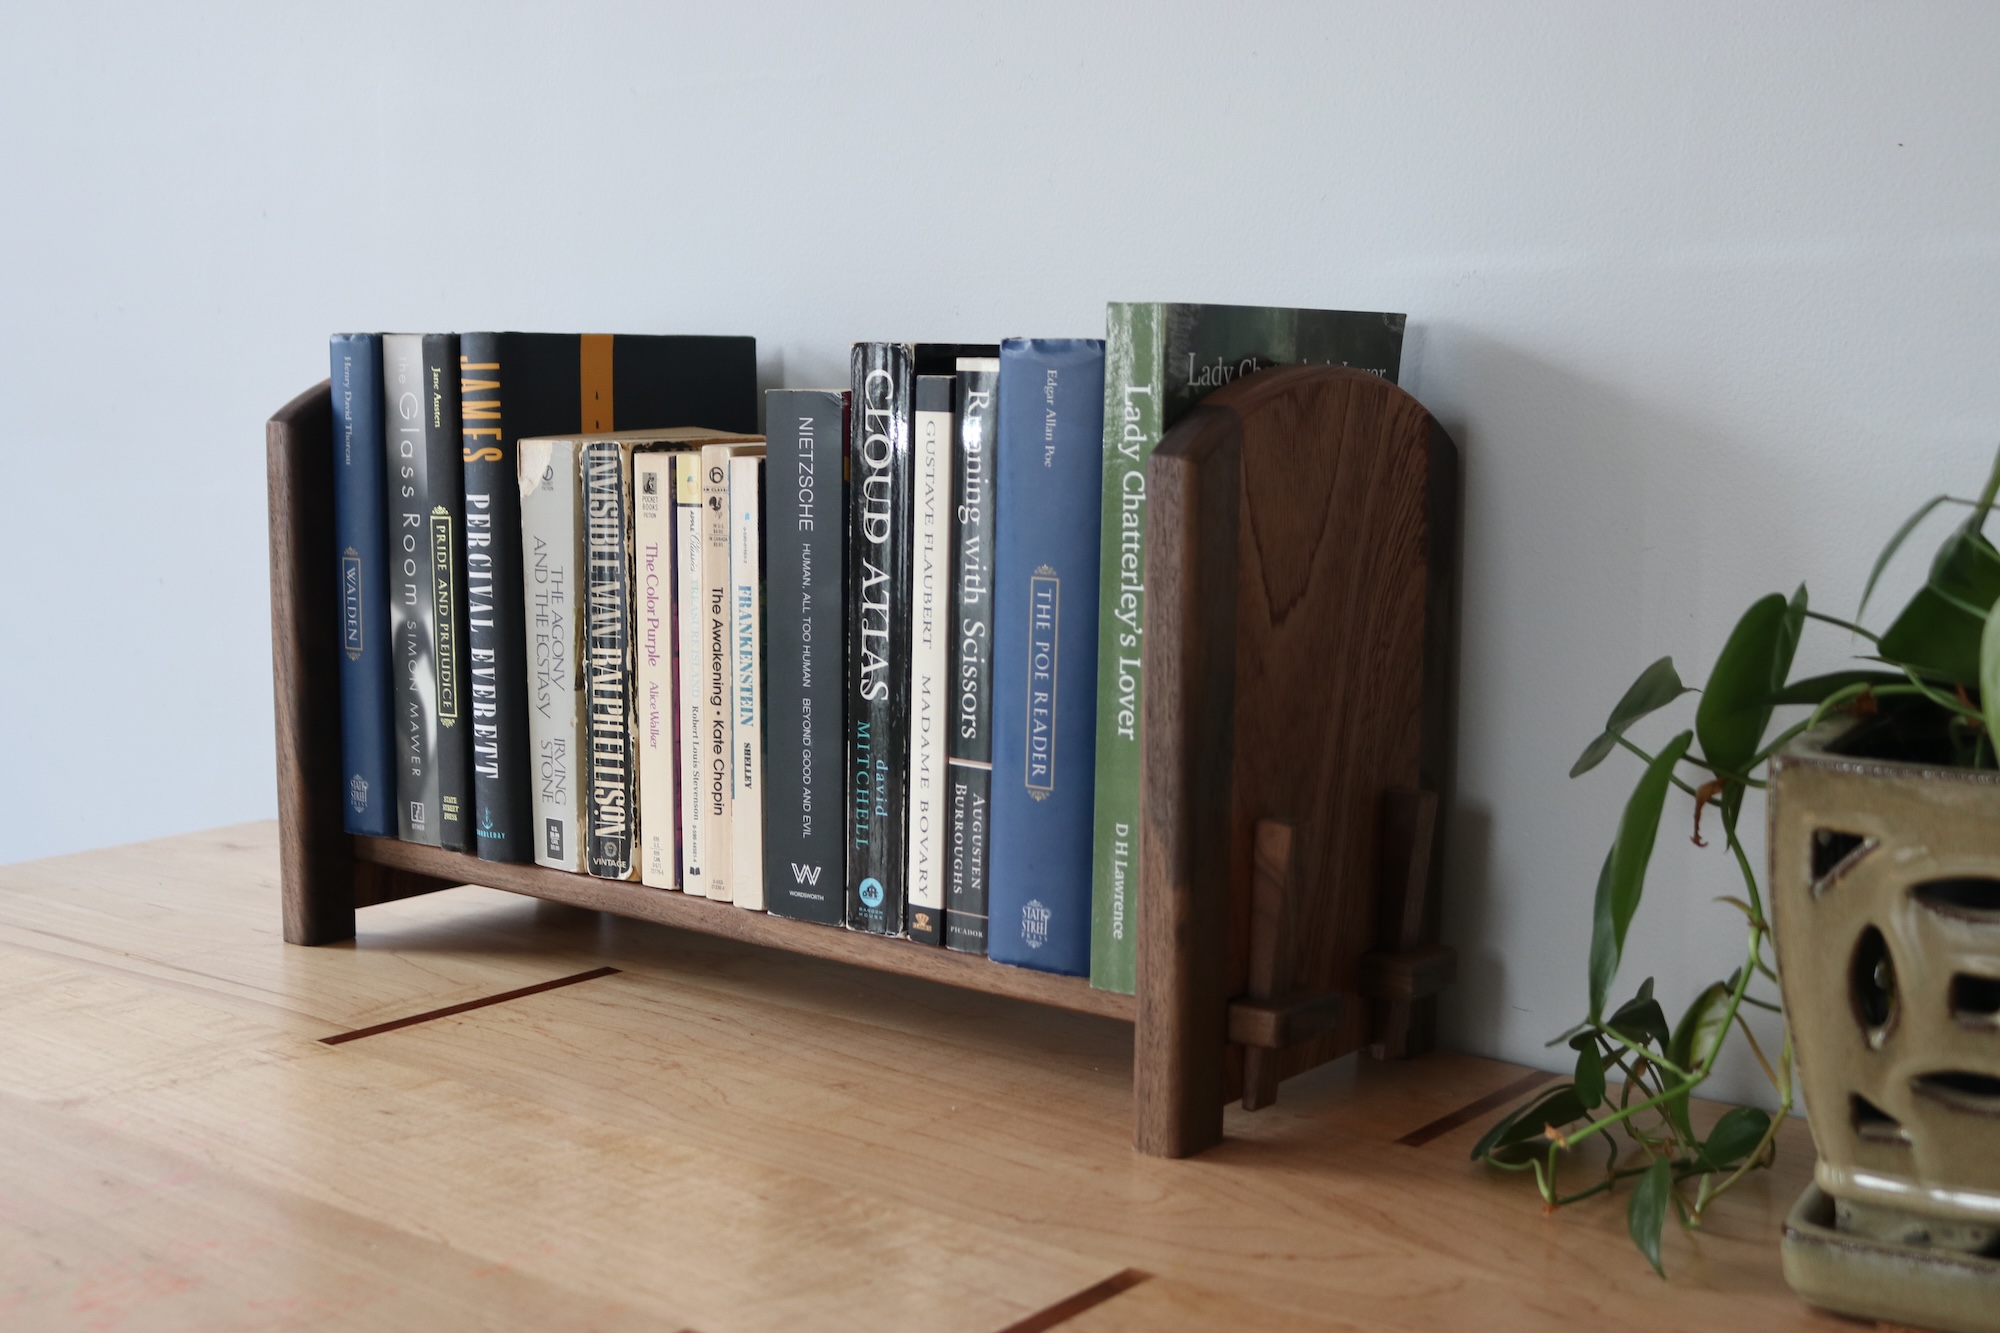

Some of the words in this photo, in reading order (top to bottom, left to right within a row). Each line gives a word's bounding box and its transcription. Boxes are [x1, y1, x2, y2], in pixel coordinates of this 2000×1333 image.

[344, 356, 352, 389] Henry
[431, 366, 441, 390] Jane
[1043, 369, 1057, 405] Edgar
[1187, 352, 1235, 386] Lady
[344, 391, 353, 421] David
[433, 391, 441, 428] Austen
[460, 355, 503, 463] JAMES
[1044, 407, 1056, 441] Allan
[1118, 384, 1151, 462] Lady
[345, 422, 353, 466] Thoreau
[399, 392, 420, 498] Glass
[863, 368, 894, 545] CLOUD
[1044, 443, 1055, 469] Poe
[798, 416, 814, 532] NIETZSCHE
[924, 420, 936, 527] GUSTAVE
[589, 450, 620, 575] INVISIBLE
[642, 496, 658, 504] POCKET
[642, 503, 658, 511] BOOKS
[402, 513, 420, 605] Room
[436, 525, 446, 571] PRIDE
[466, 493, 494, 633] PERCIVAL
[533, 535, 549, 584] AND
[645, 543, 658, 571] The
[690, 532, 701, 572] Classics
[801, 542, 811, 590] HUMAN,
[963, 535, 988, 605] with
[1114, 470, 1147, 647] Chatterley's
[346, 567, 358, 641] WALDEN
[438, 579, 448, 621] AND
[535, 591, 549, 627] THE
[551, 566, 563, 604] THE
[645, 573, 659, 616] Color
[712, 587, 724, 613] The
[801, 592, 811, 614] ALL
[922, 532, 934, 650] FLAUBERT
[1035, 588, 1052, 630] THE
[590, 580, 621, 640] MAN
[690, 579, 699, 647] TREASURE
[801, 616, 811, 644] TOO
[859, 557, 892, 702] ATLAS
[406, 620, 418, 692] SIMON
[440, 623, 452, 708] PREJUDICE
[551, 610, 565, 692] AGONY
[645, 617, 660, 668] Purple
[710, 617, 724, 707] Awakening
[739, 584, 754, 727] FRANKENSTEIN
[801, 645, 811, 688] HUMAN
[1034, 640, 1050, 681] POE
[536, 634, 551, 719] ECSTASY
[592, 647, 623, 732] RALPH
[650, 681, 659, 709] Alice
[691, 654, 700, 698] ISLAND
[961, 618, 986, 740] Scissors
[1117, 656, 1141, 741] Lover
[472, 647, 499, 779] EVERETT
[650, 710, 660, 750] Walker
[713, 719, 725, 755] Kate
[802, 697, 812, 746] BEYOND
[920, 675, 931, 789] MADAME
[1031, 691, 1049, 778] READER
[410, 701, 421, 777] MAWER
[541, 740, 554, 804] STONE
[554, 737, 566, 806] IRVING
[711, 758, 725, 817] Chopin
[744, 742, 752, 790] SHELLEY
[802, 748, 812, 786] GOOD
[855, 720, 871, 850] MITCHELL
[875, 759, 889, 818] david
[692, 770, 701, 821] Stevenson
[802, 787, 812, 813] AND
[802, 814, 812, 839] EVIL
[918, 799, 929, 899] BOVARY
[953, 783, 967, 895] BURROUGHS
[971, 792, 986, 890] AUGUSTEN
[1115, 822, 1128, 837] D
[1115, 842, 1128, 856] H
[592, 857, 627, 869] VINTAGE
[789, 890, 825, 902] WORDSWORTH
[858, 906, 884, 915] RANDOM
[858, 912, 883, 921] HOUSE
[1112, 859, 1128, 940] Lawrence
[950, 925, 984, 938] PICADOR
[1022, 919, 1048, 936] STREET
